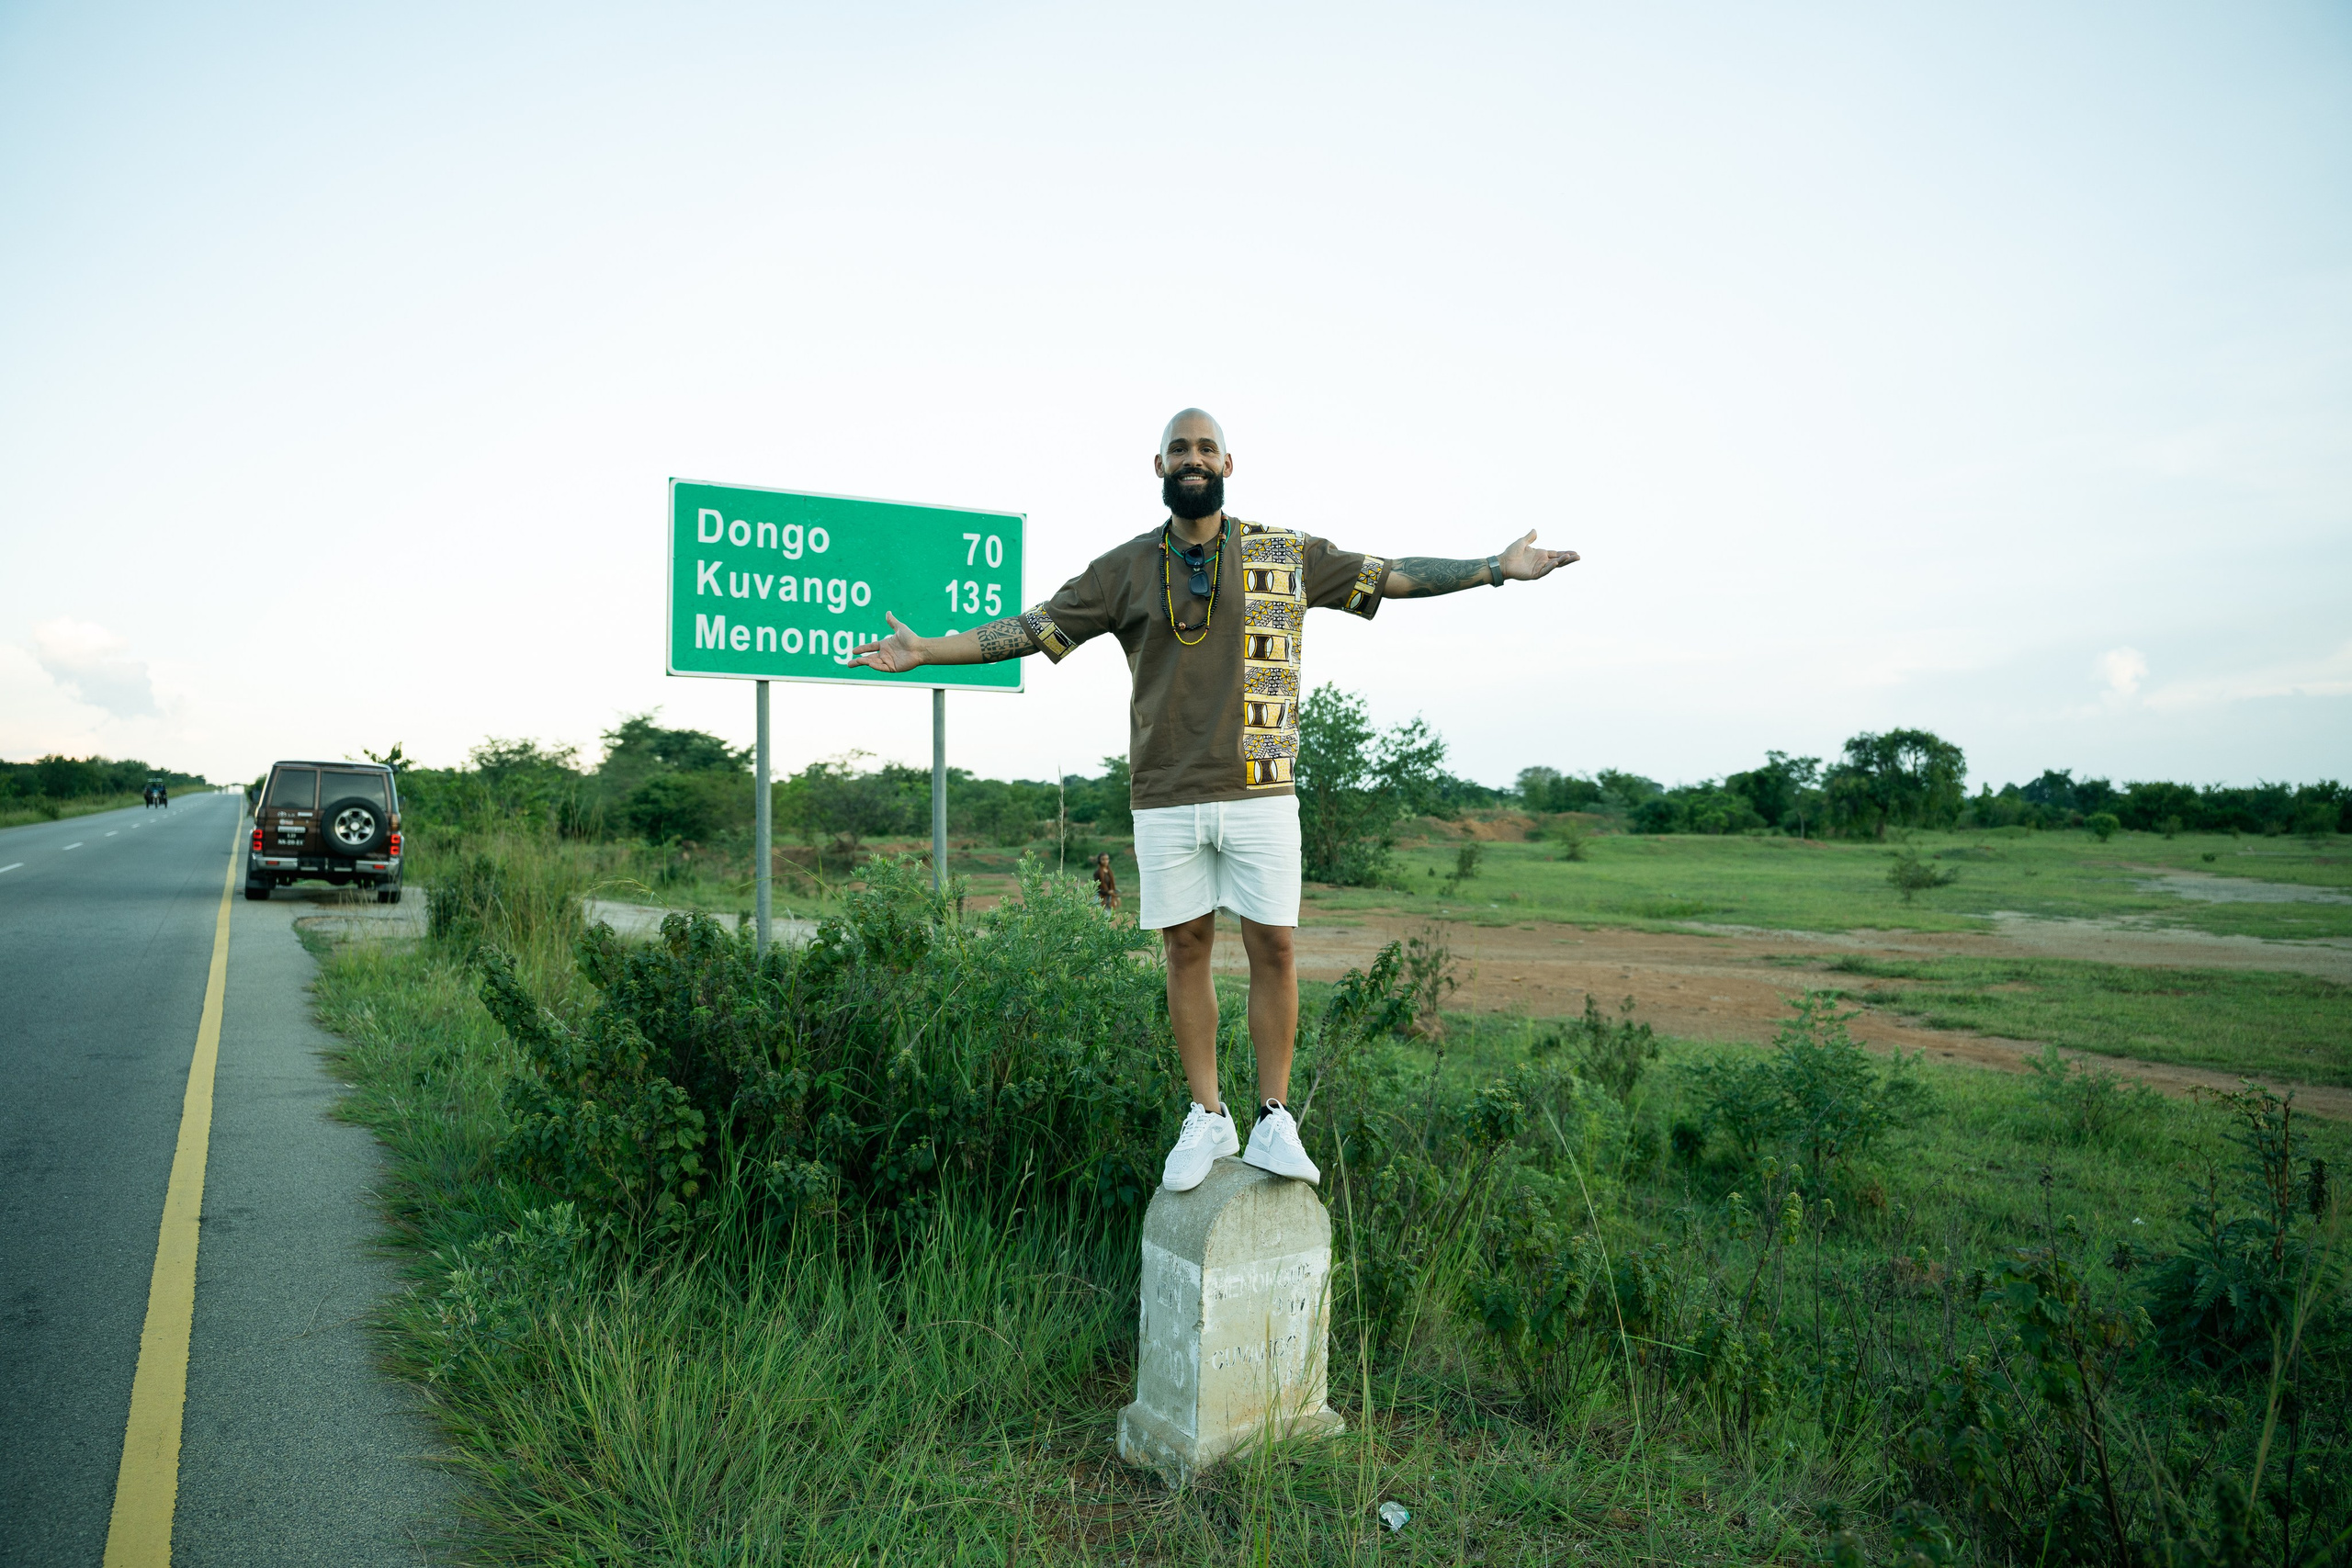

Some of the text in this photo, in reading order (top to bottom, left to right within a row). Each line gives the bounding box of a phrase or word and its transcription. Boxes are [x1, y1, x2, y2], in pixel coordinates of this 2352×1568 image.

[697, 507, 1003, 569] Dongo 70
[696, 559, 1002, 616] Kuvango 135
[695, 614, 894, 665] Menongu
